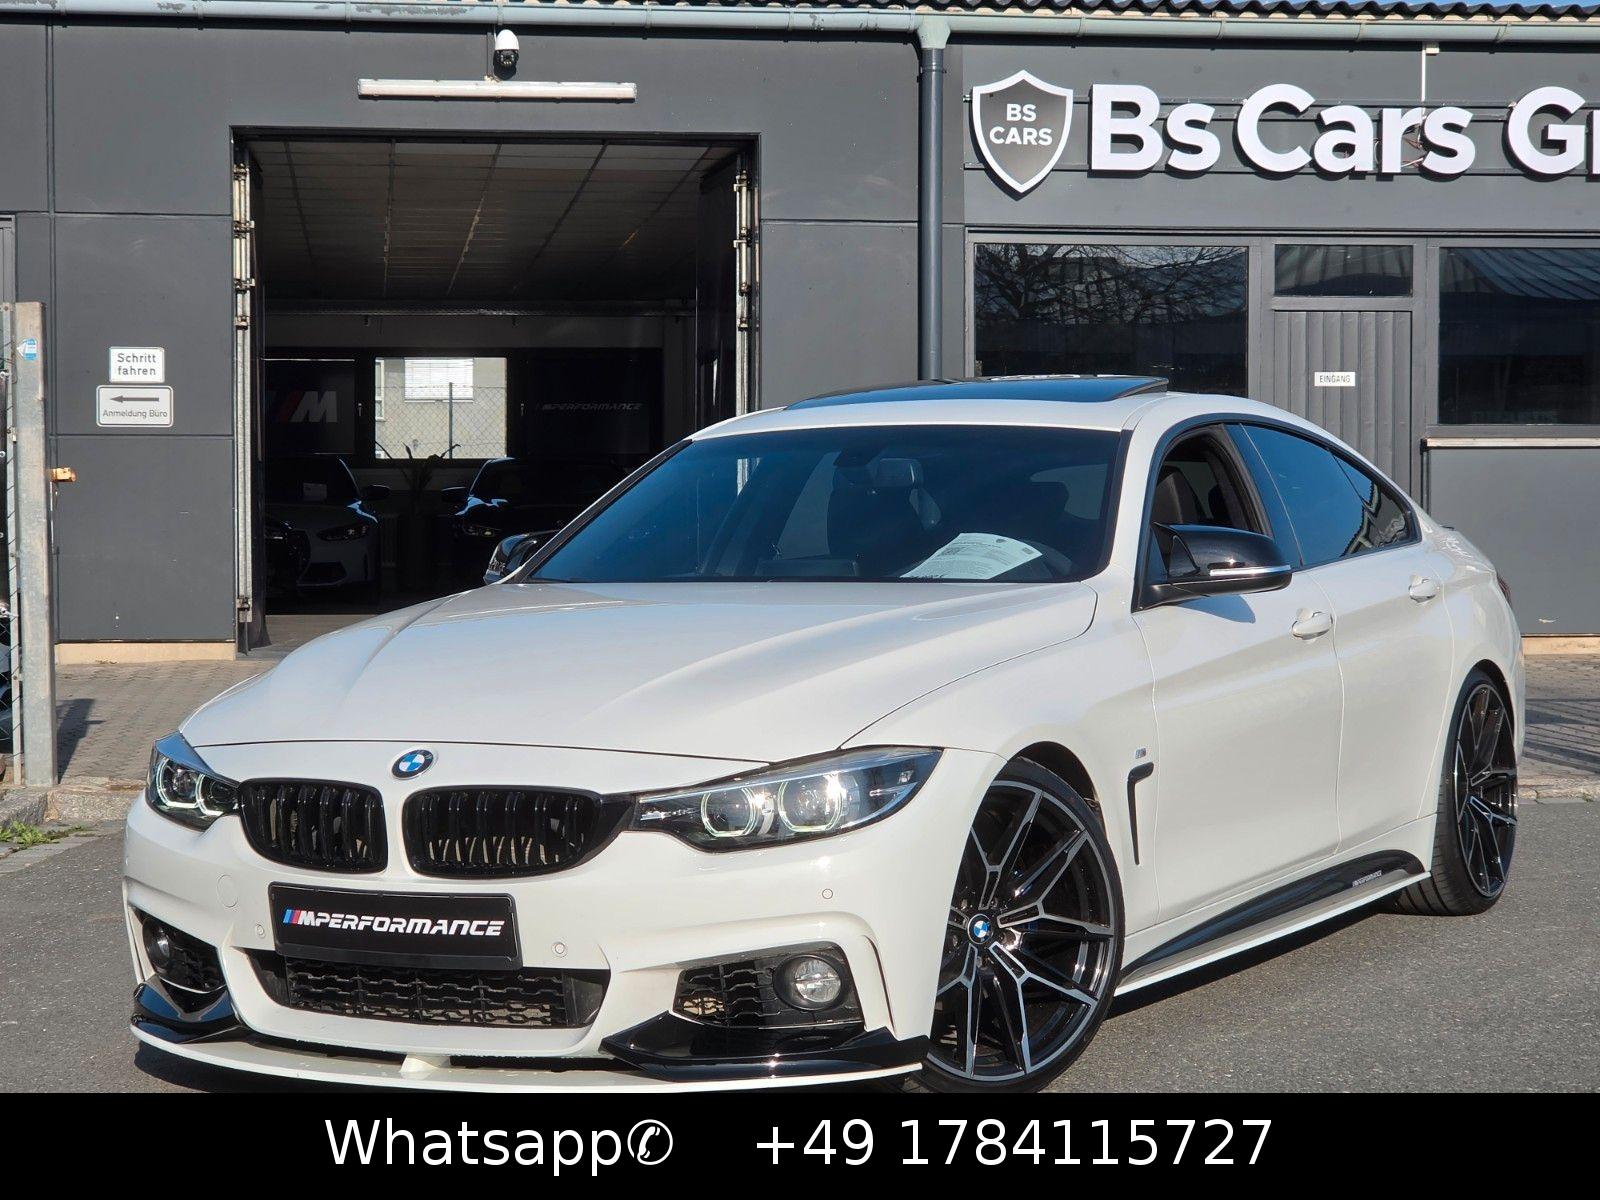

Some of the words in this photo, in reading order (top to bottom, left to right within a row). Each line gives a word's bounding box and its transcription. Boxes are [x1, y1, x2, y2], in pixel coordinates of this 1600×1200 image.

[1006, 103, 1037, 122] BS
[1091, 84, 1221, 171] Bs
[1236, 83, 1476, 174] Cars
[989, 126, 1053, 146] CARS
[116, 352, 157, 363] Schritt
[117, 366, 156, 376] fahren
[1319, 374, 1351, 384] EINGANG
[102, 409, 147, 419] Anmeldung
[149, 409, 168, 418] Büro
